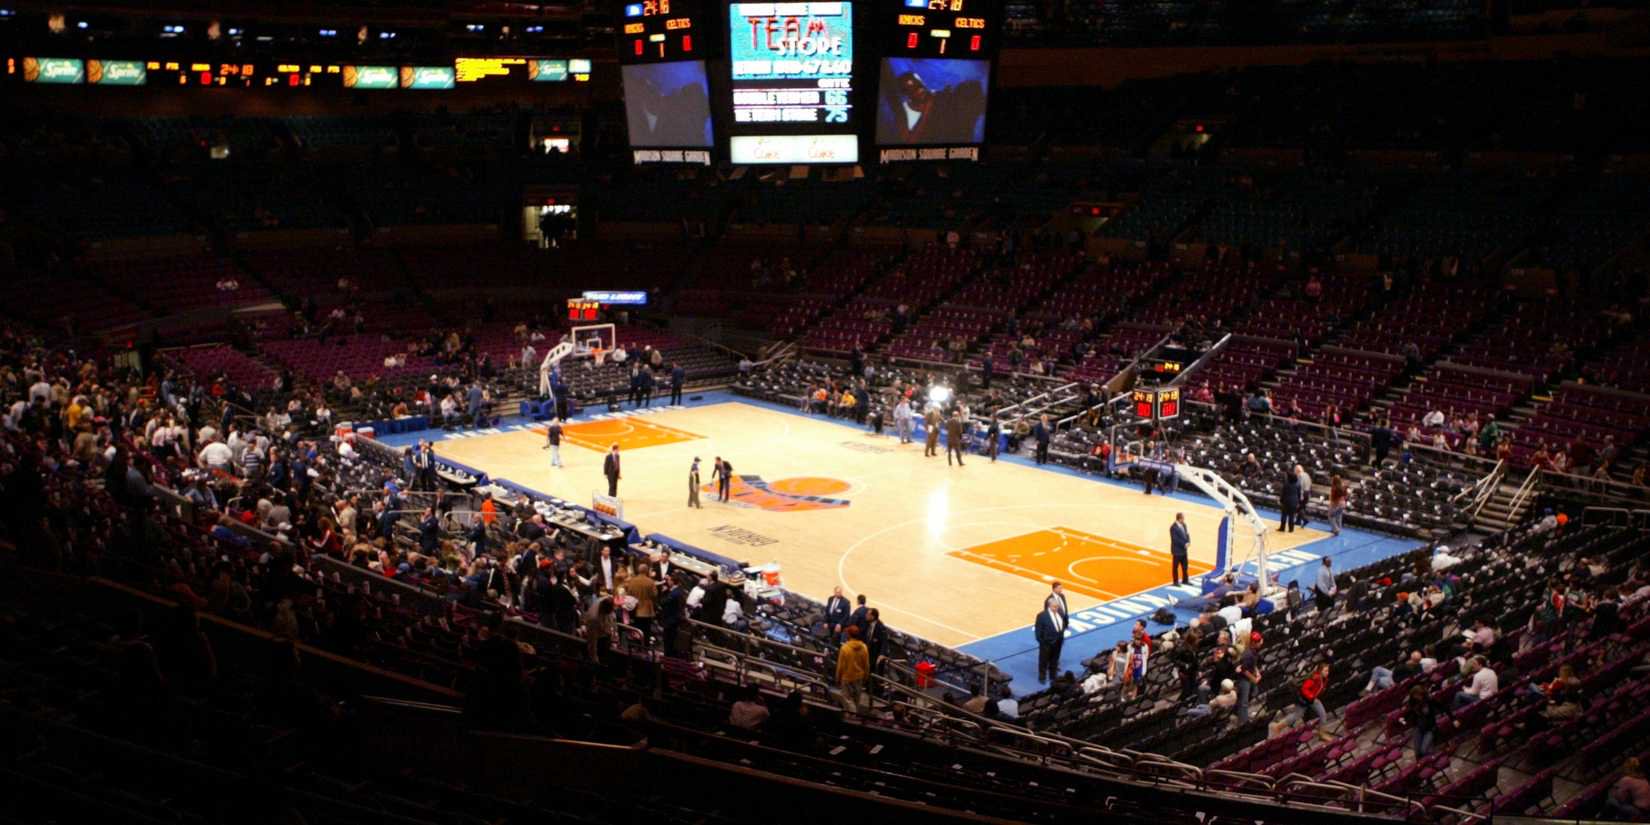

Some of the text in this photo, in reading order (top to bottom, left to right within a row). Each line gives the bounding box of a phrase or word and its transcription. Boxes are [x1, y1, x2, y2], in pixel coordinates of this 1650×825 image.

[955, 17, 985, 29] CELTICS
[748, 16, 832, 51] TEAM
[778, 37, 842, 57] STORE
[44, 61, 78, 79] Sprite
[107, 63, 141, 80] Sprite
